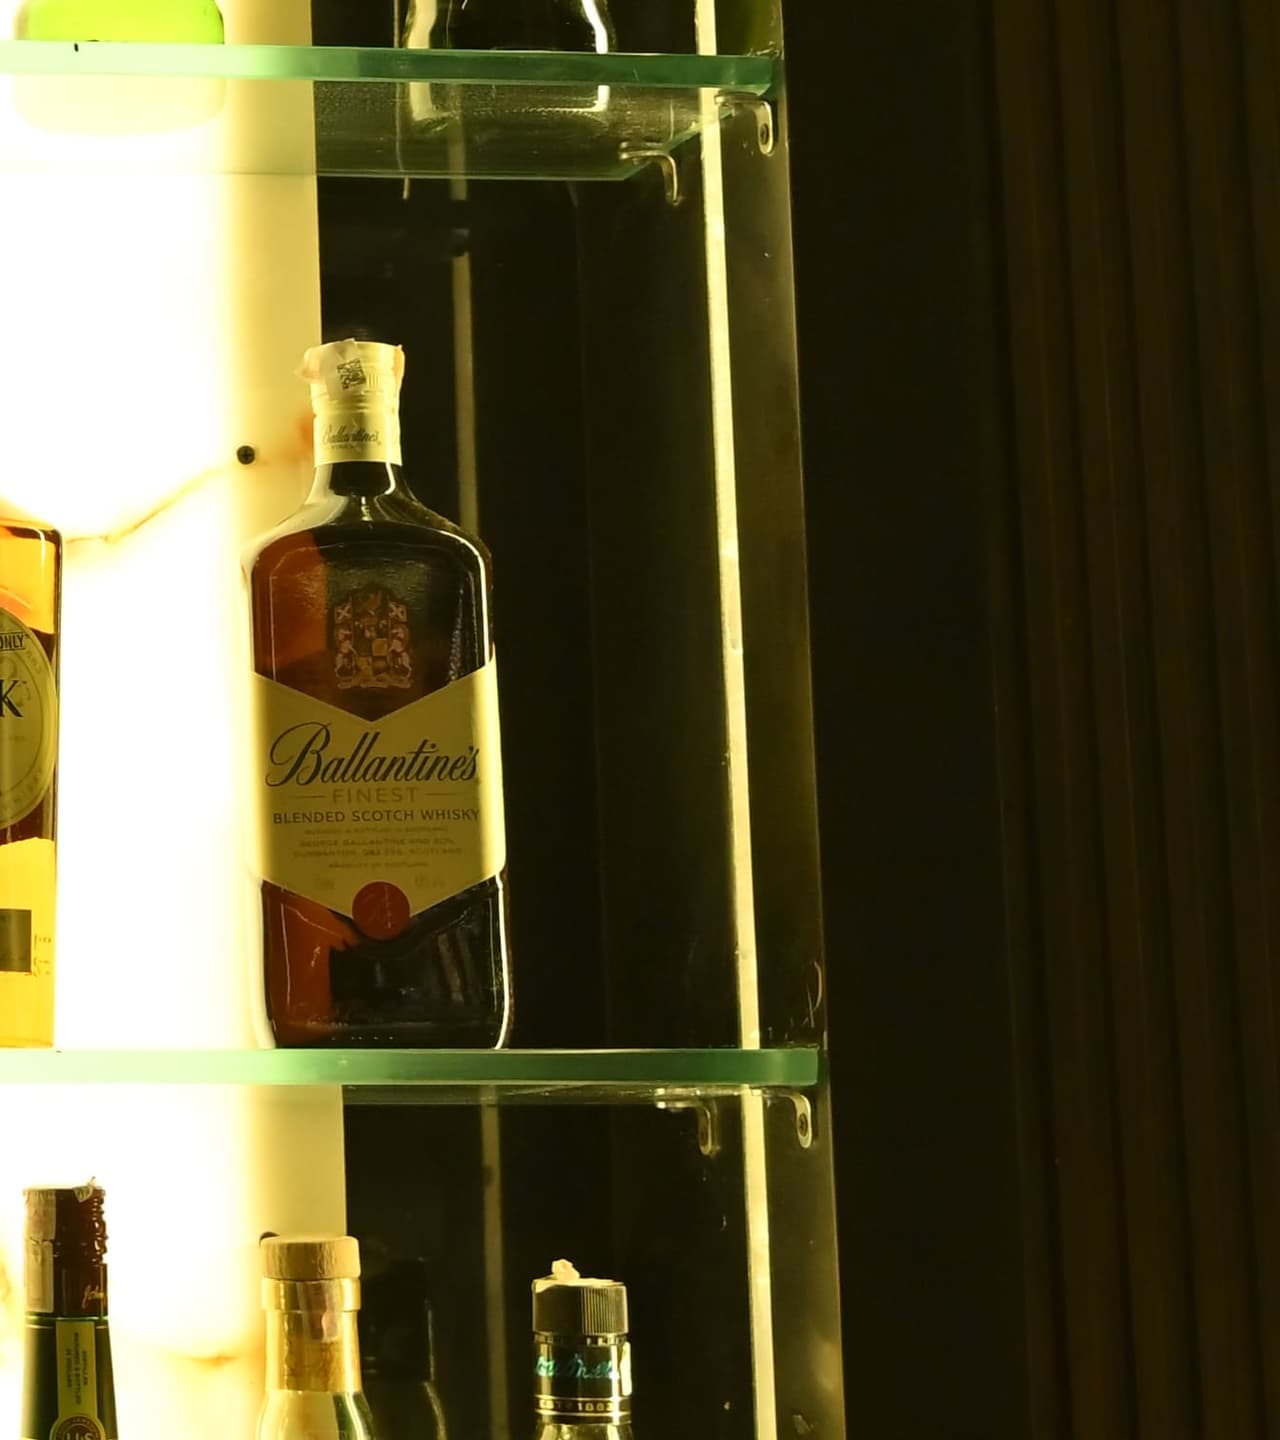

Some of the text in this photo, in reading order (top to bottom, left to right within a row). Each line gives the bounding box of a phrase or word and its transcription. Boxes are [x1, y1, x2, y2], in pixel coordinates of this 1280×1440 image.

[265, 721, 480, 788] Ballantine's
[331, 787, 418, 804] FINEST
[272, 807, 480, 825] BLENDED SCOTCH WHISKY
